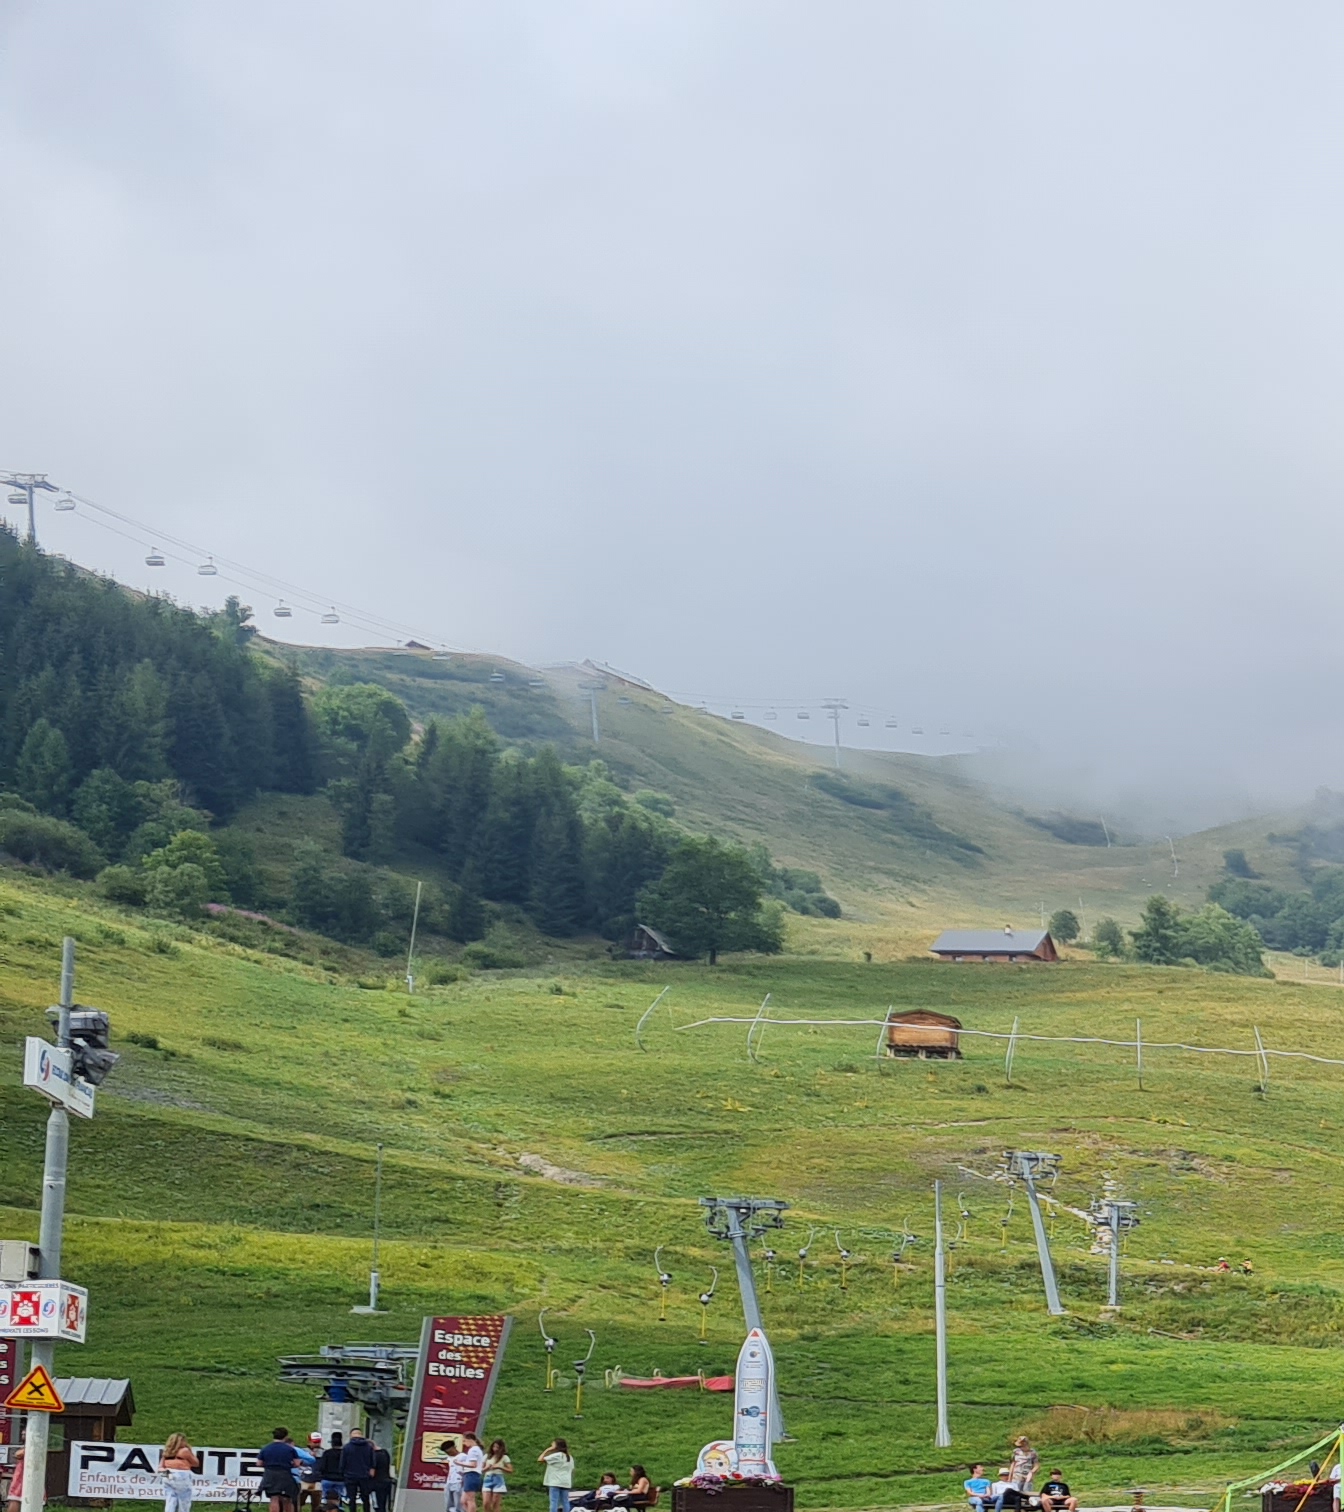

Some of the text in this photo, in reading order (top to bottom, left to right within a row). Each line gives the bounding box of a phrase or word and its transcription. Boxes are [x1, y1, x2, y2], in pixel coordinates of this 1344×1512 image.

[434, 1330, 491, 1347] Espace
[438, 1350, 462, 1360] des
[428, 1363, 485, 1379] Etoiles
[80, 1471, 126, 1484] Enfants
[130, 1473, 146, 1484] de
[79, 1483, 125, 1494] Famille
